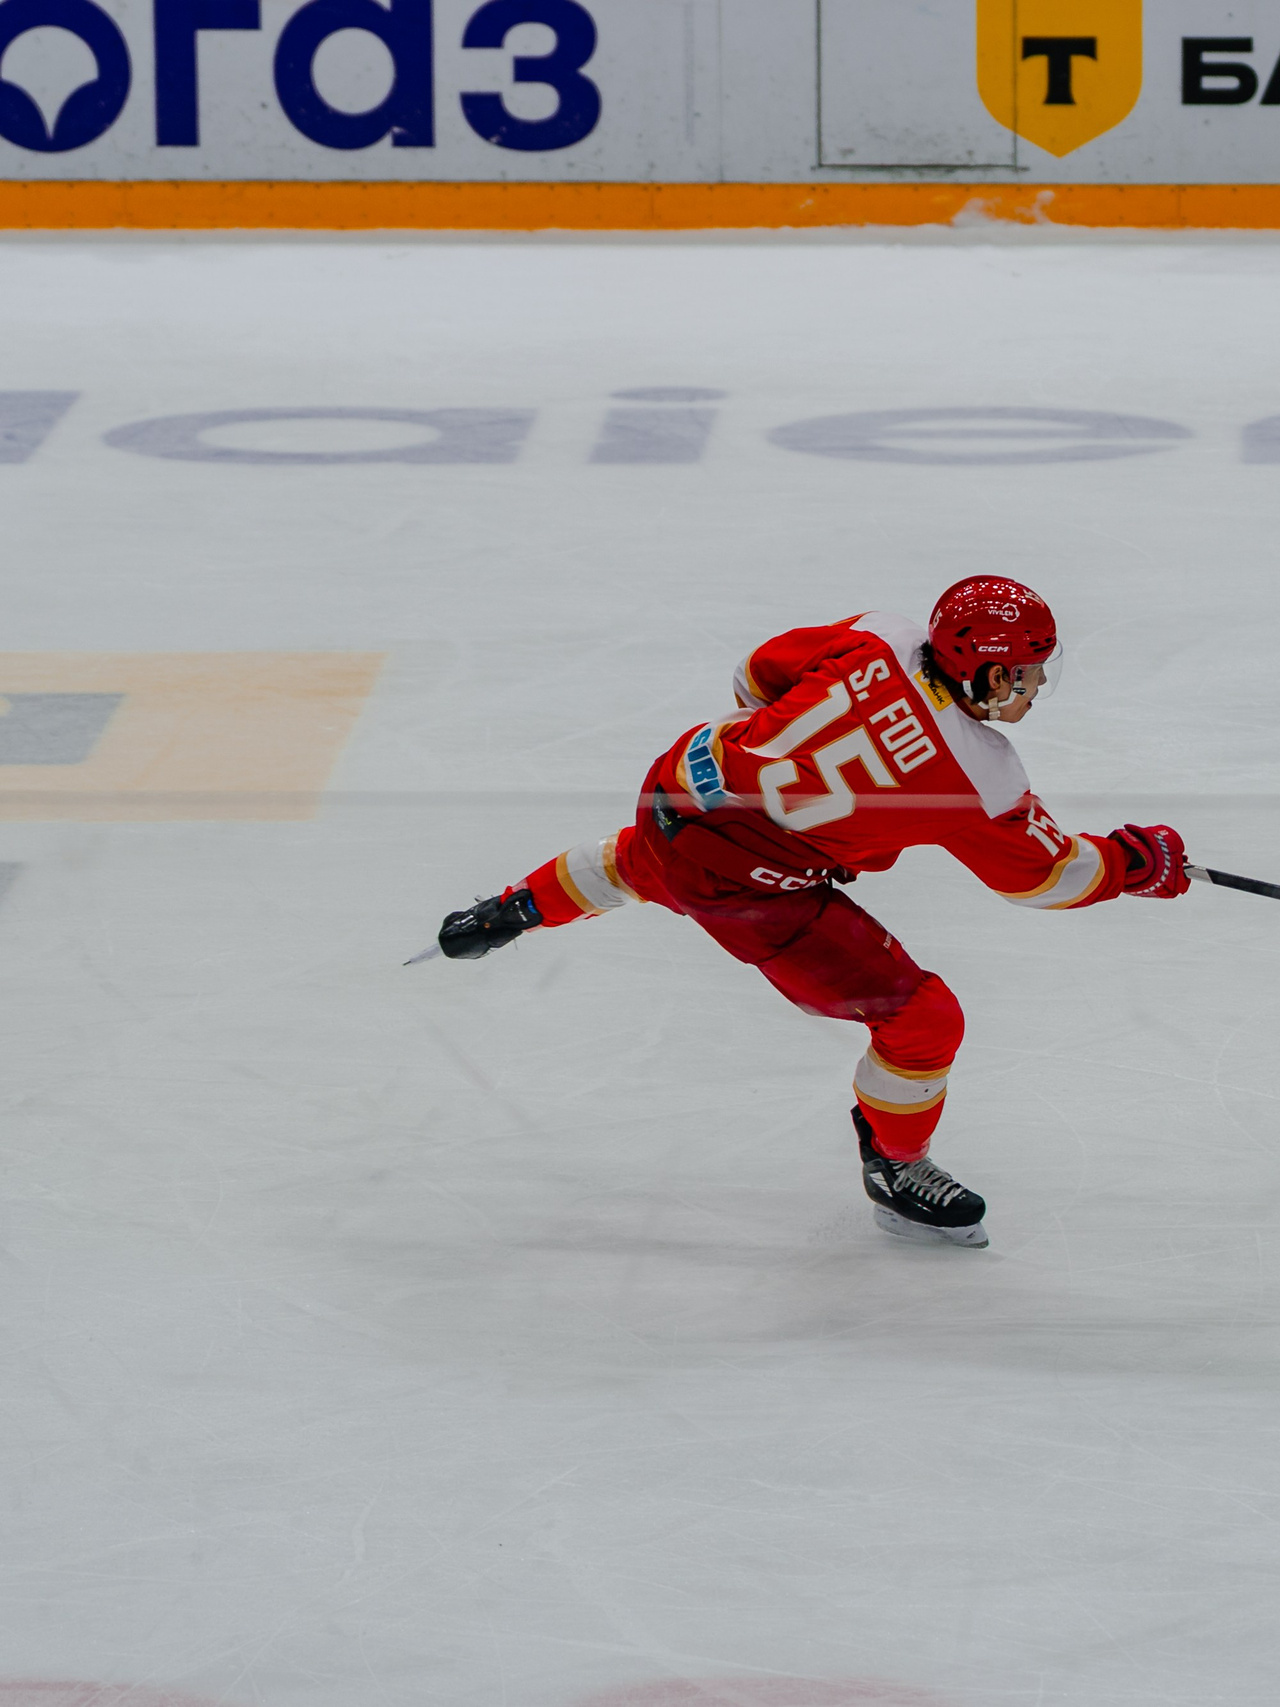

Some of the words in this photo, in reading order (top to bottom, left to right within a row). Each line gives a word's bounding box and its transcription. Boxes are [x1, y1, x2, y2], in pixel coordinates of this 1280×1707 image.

[978, 645, 1009, 653] CCM
[848, 658, 889, 702] S.
[740, 680, 901, 832] 15
[868, 697, 937, 774] FOO
[1026, 800, 1065, 857] 15
